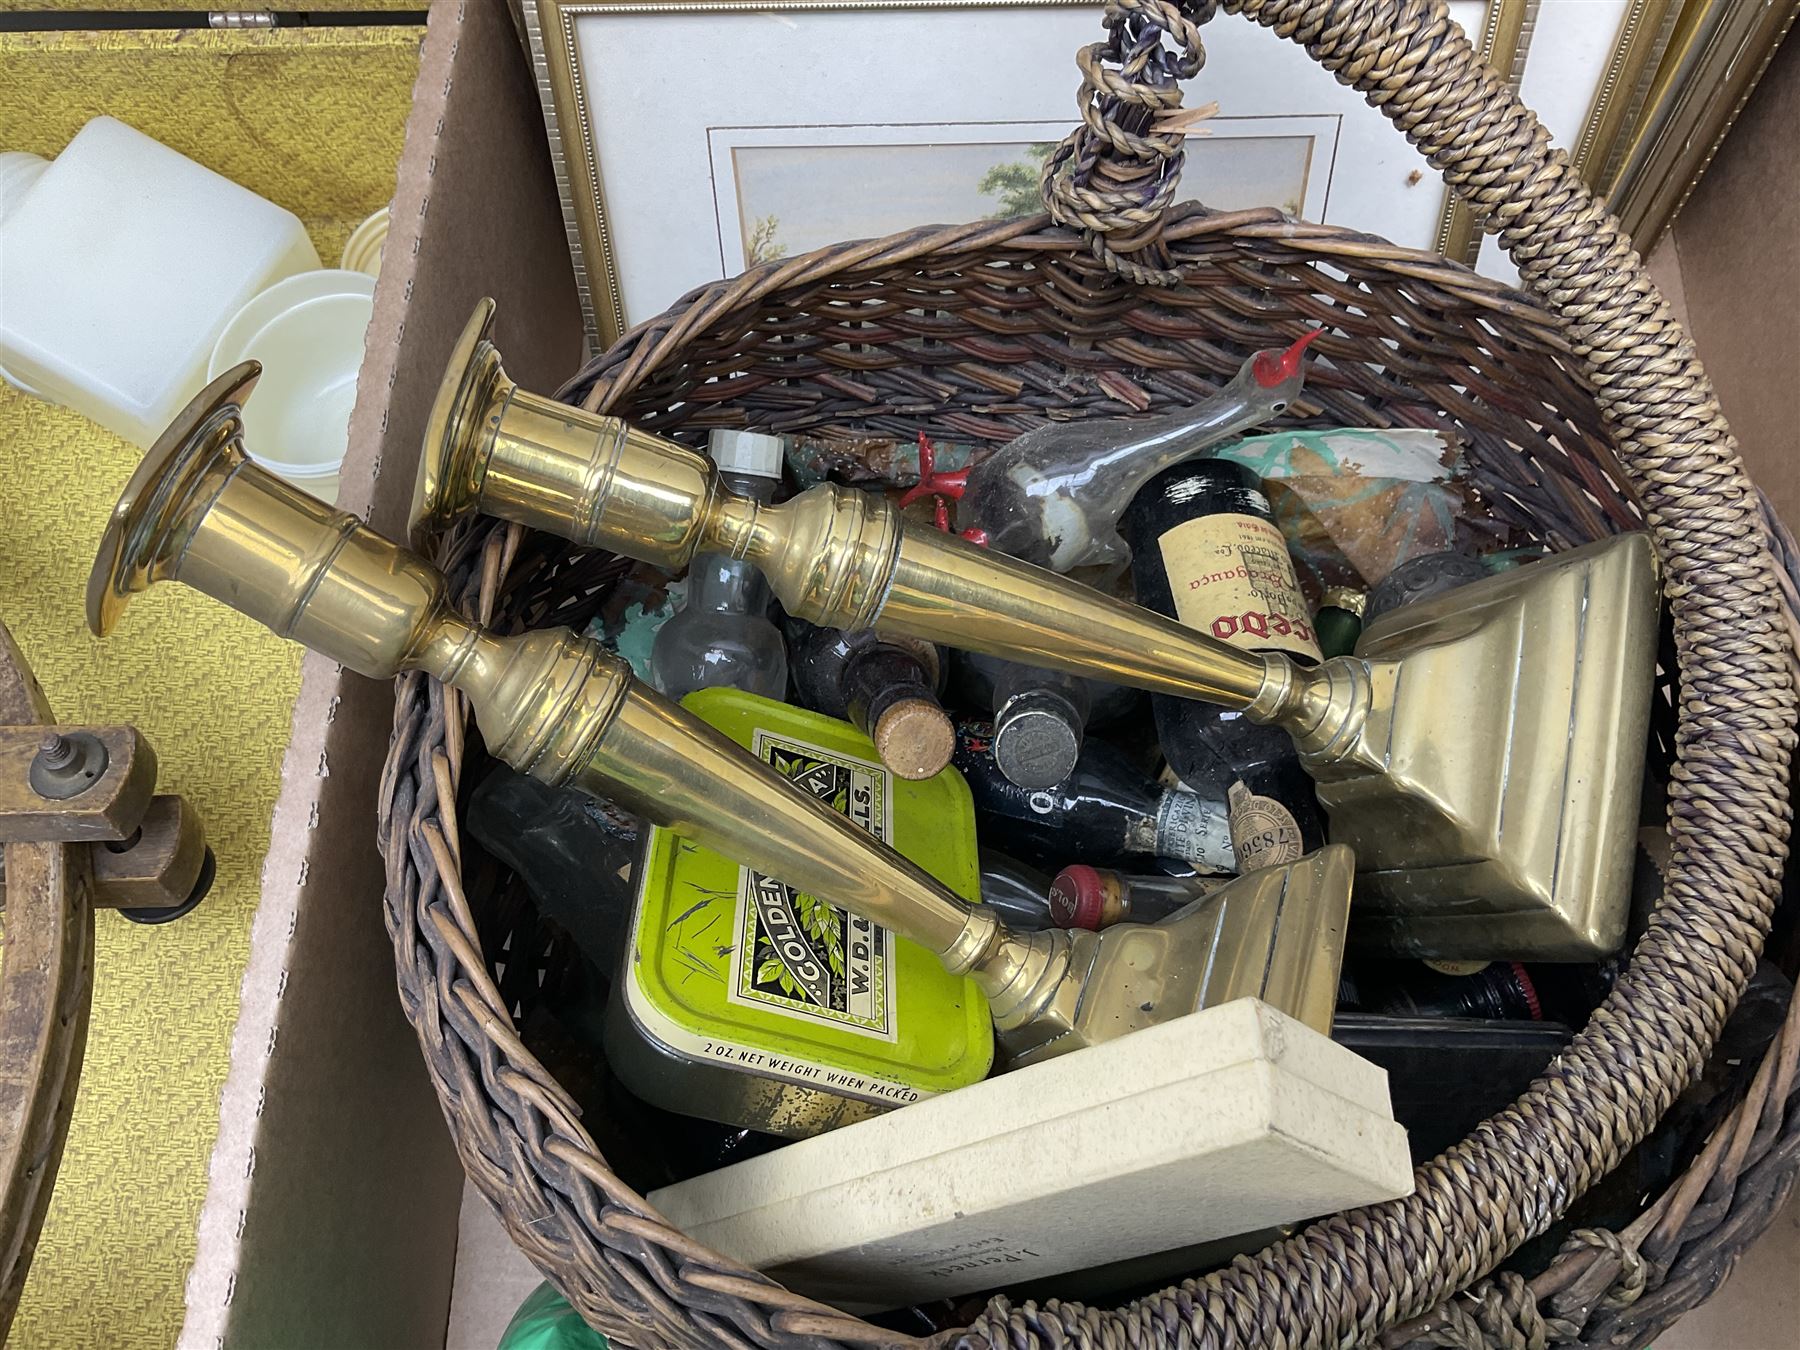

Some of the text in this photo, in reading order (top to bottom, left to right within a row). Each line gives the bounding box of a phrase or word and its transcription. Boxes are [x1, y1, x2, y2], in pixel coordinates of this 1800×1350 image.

[703, 1042, 919, 1103] 2 OZ. NET WEIGHT WHEN PACKED
